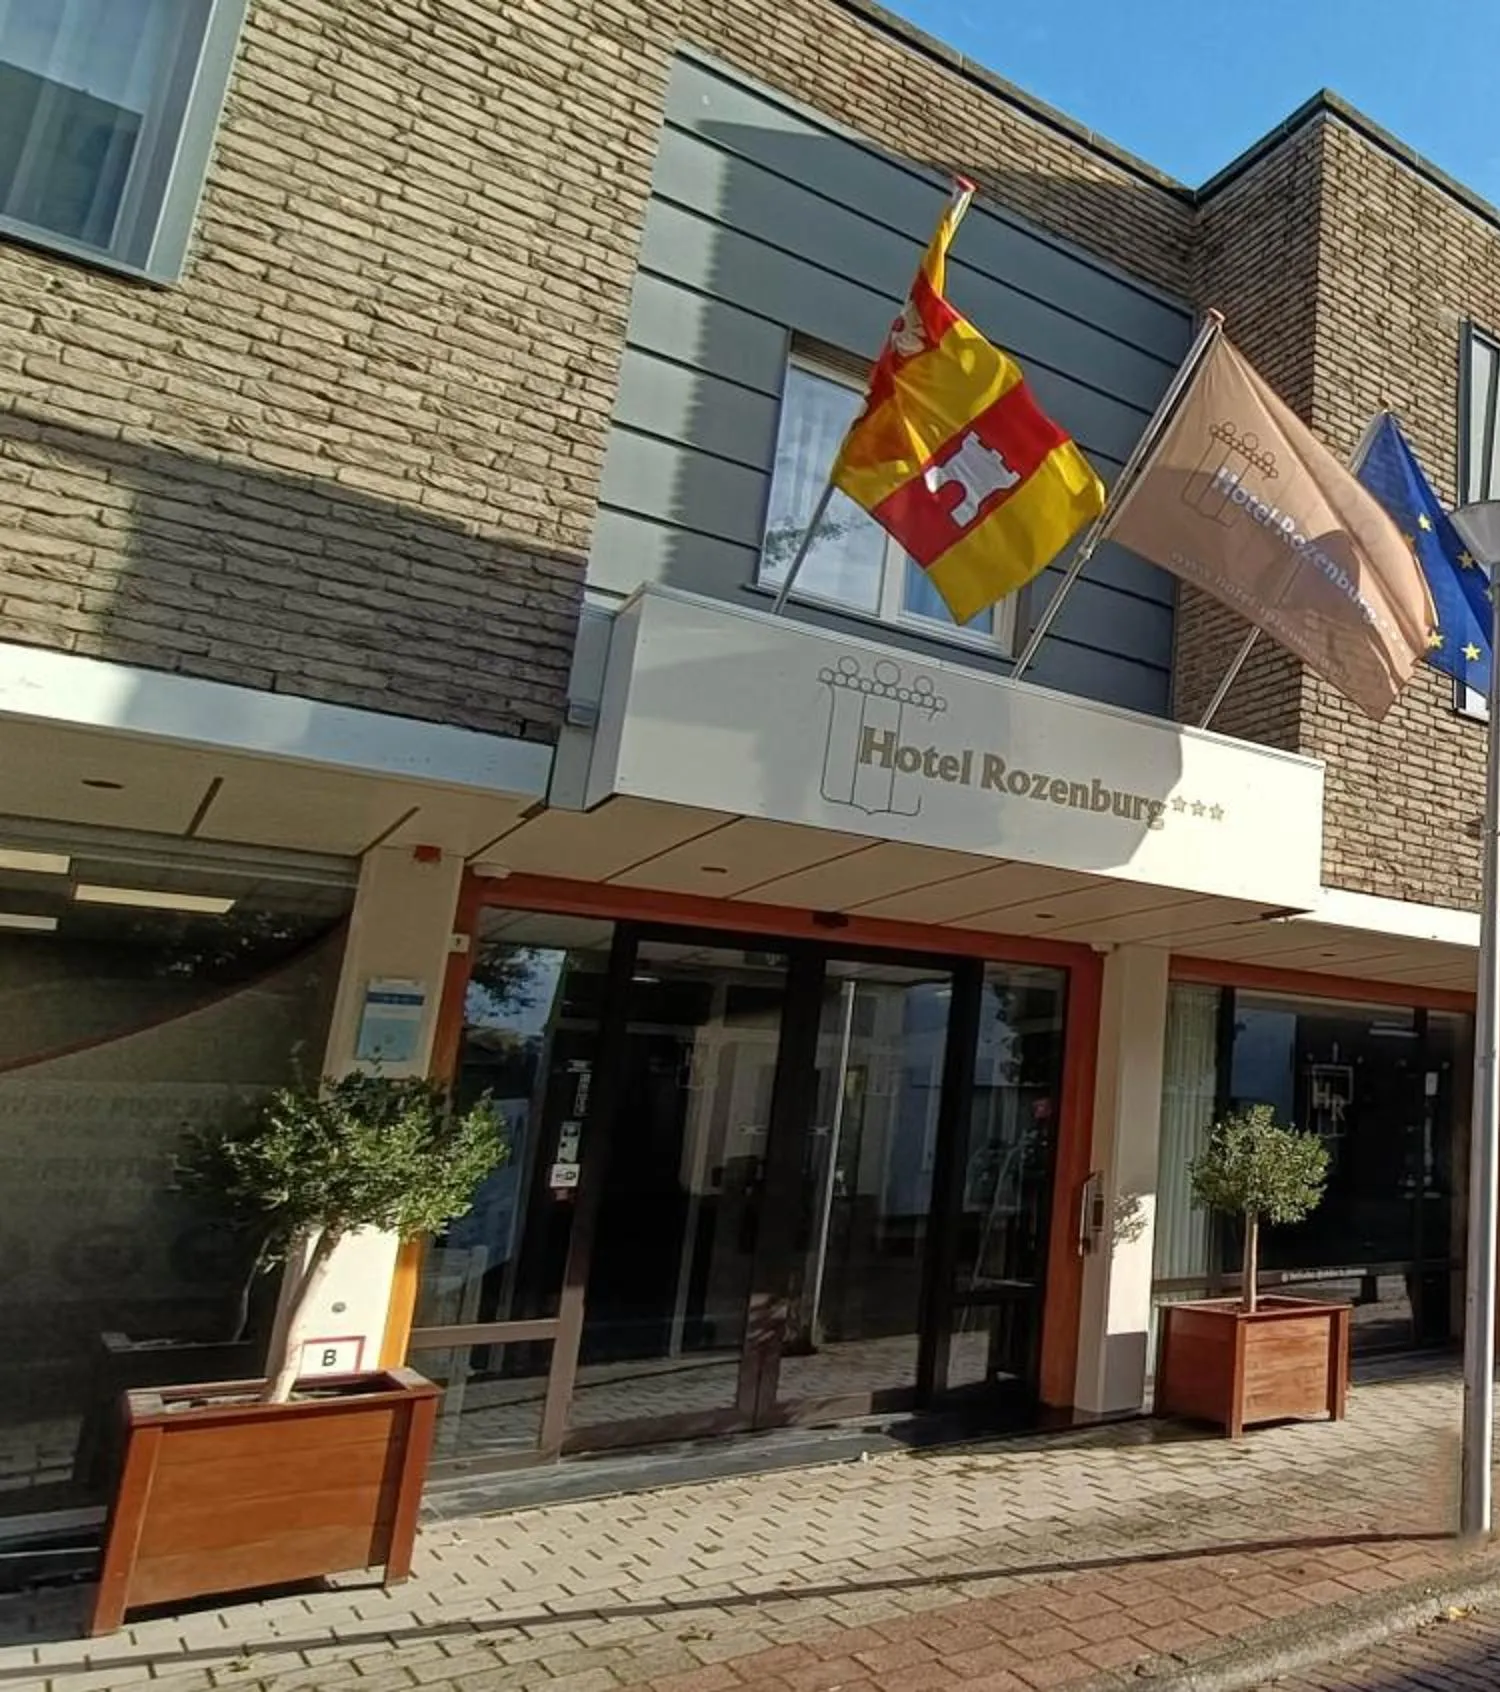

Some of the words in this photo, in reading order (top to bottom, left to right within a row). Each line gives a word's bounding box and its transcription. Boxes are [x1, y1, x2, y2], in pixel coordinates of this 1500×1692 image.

[1211, 466, 1280, 527] Hotel
[858, 726, 973, 785] Hotel
[979, 752, 1165, 830] Rozenburg
[321, 1348, 337, 1367] B
